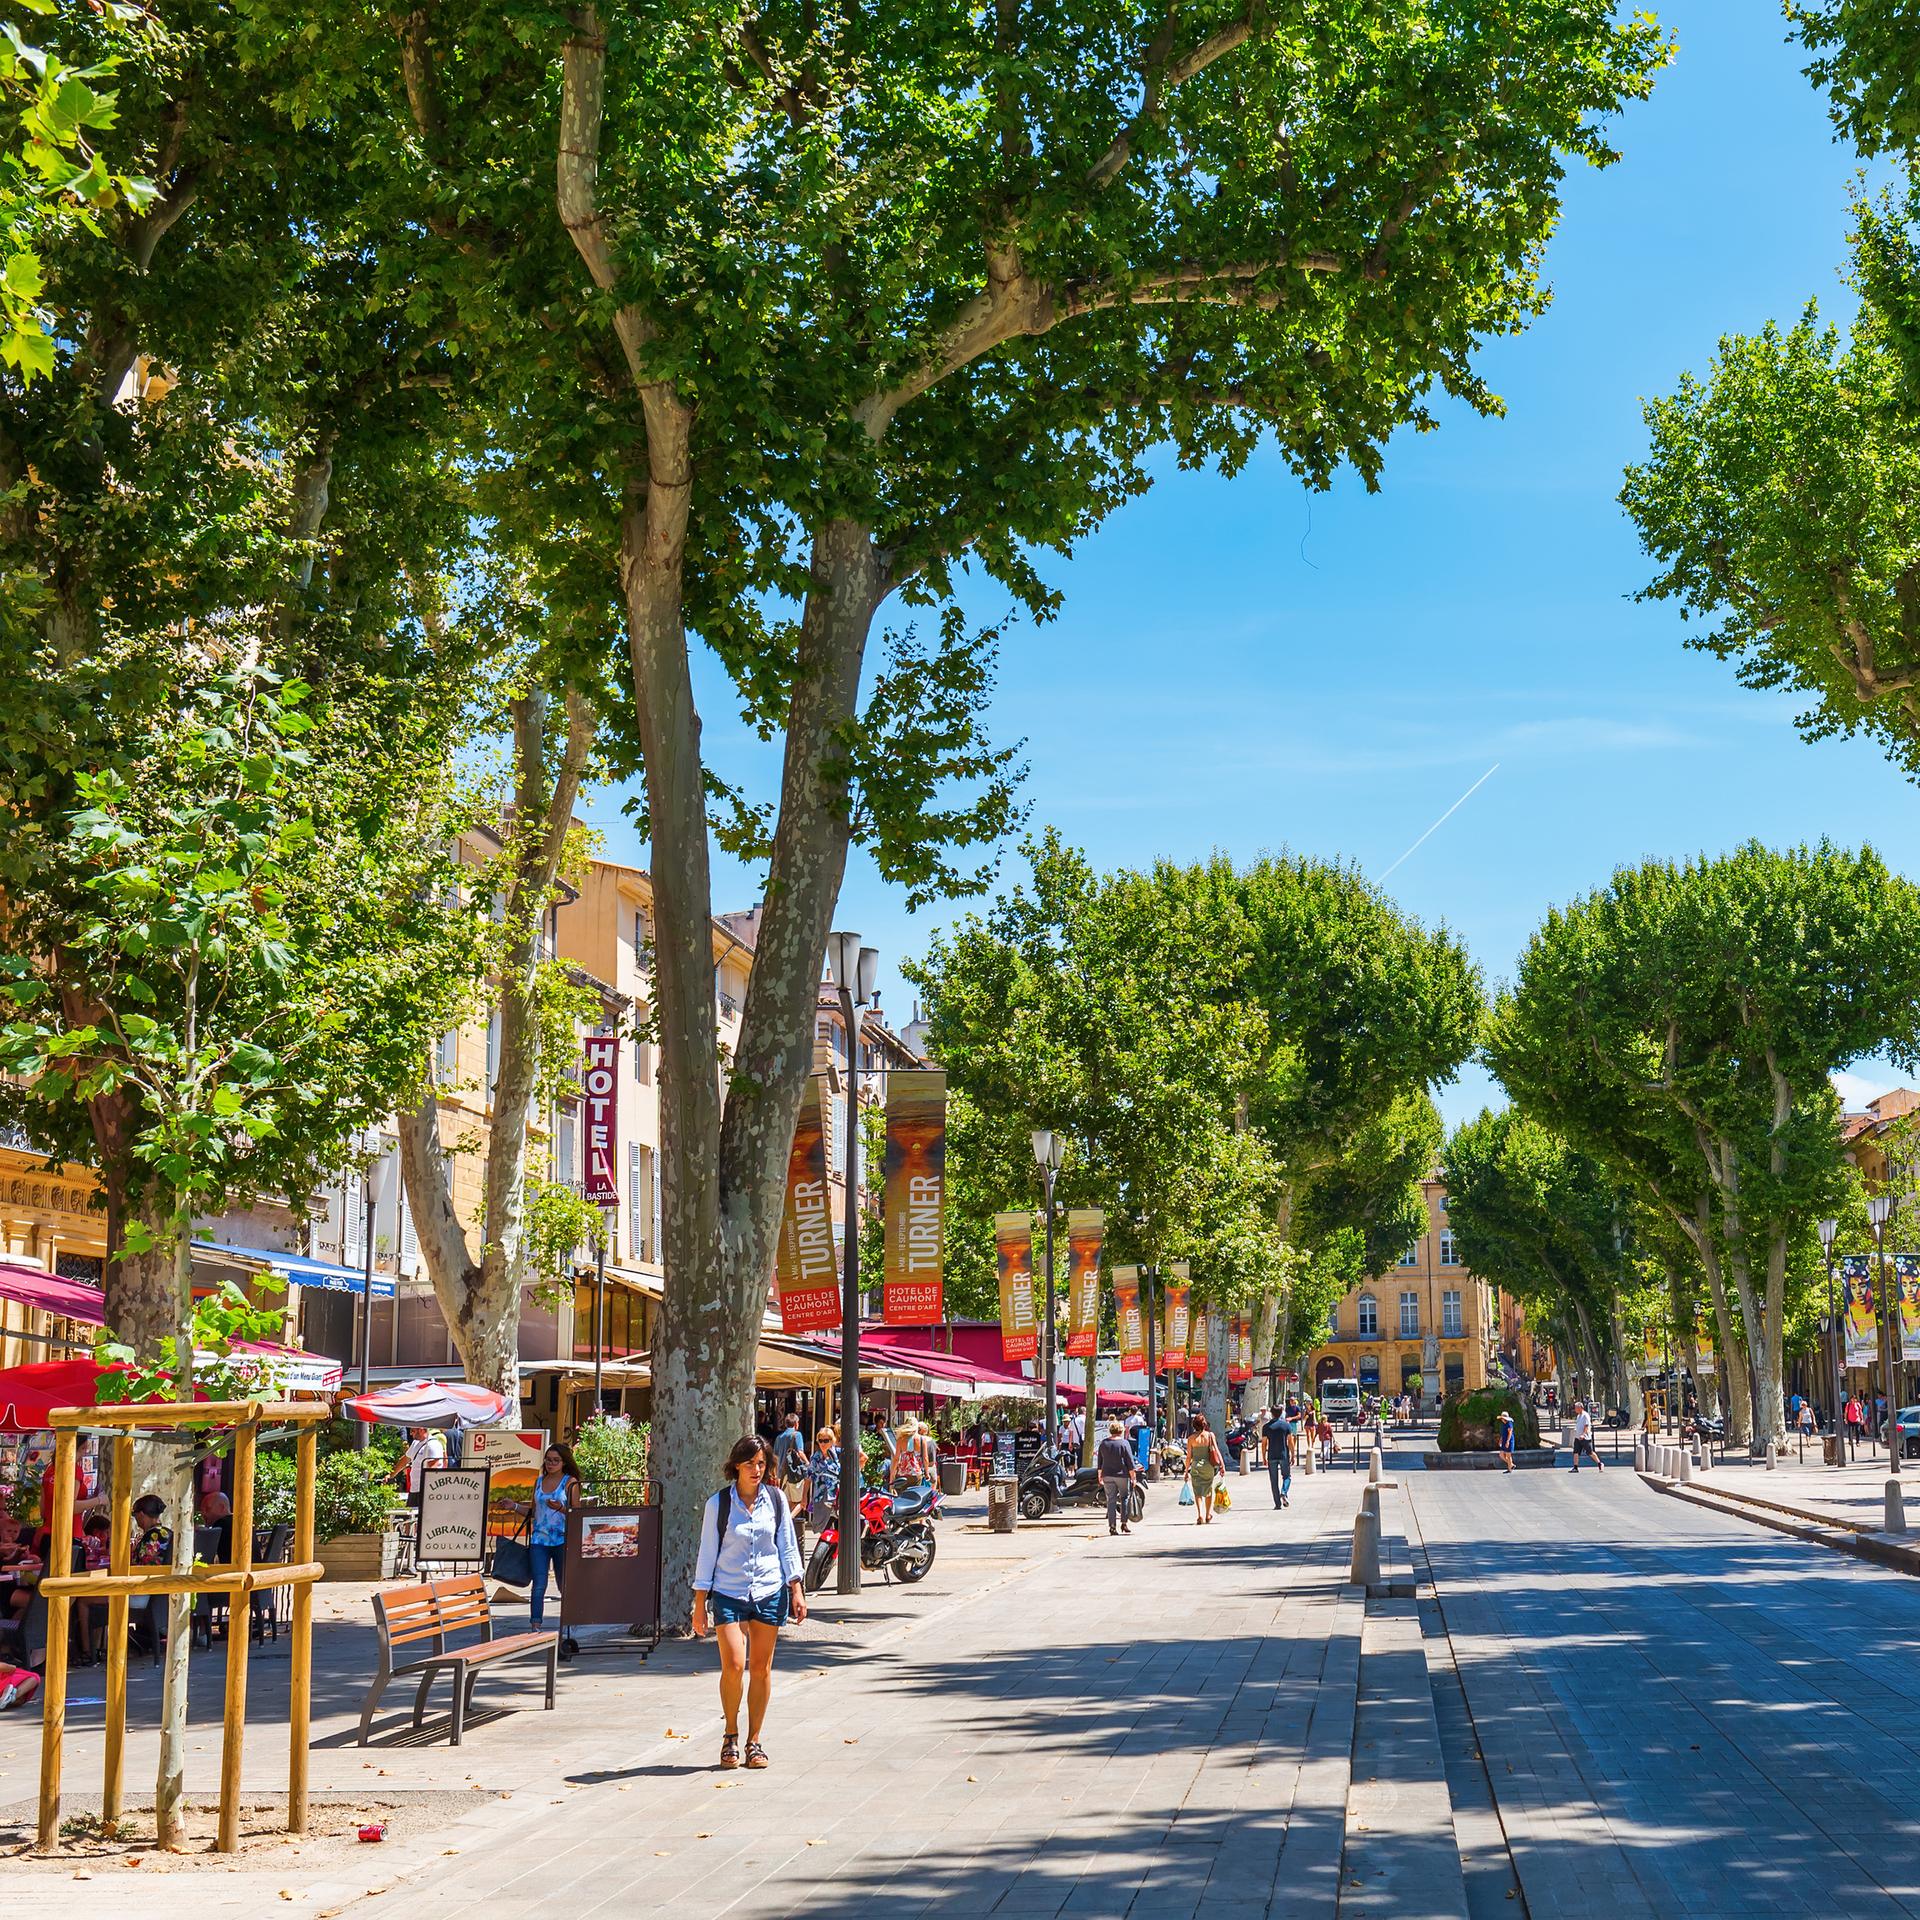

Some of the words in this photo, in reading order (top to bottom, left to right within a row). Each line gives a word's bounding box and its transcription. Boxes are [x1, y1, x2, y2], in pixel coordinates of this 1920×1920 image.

[588, 1044, 614, 1175] HOTEL
[597, 1183, 607, 1191] LA
[586, 1191, 617, 1200] BASTIDE
[794, 1179, 831, 1280] TURNER
[908, 1175, 940, 1273] TURNER
[785, 1292, 817, 1304] HOTEL
[819, 1290, 835, 1299] DE
[889, 1287, 922, 1296] HOTEL
[925, 1286, 938, 1294] DE
[1082, 1269, 1099, 1328] TURNER
[786, 1299, 835, 1312] CAUMONT
[889, 1295, 937, 1303] CAUMONT
[1012, 1271, 1034, 1330] TURNER
[787, 1311, 815, 1320] CENTRE
[816, 1308, 836, 1317] D'ART
[1126, 1308, 1142, 1350] TURNER
[1174, 1306, 1188, 1347] TURNER
[1194, 1315, 1206, 1352] TURNER
[1006, 1341, 1034, 1349] CAUMONT
[1229, 1333, 1239, 1363] TURNER
[429, 1476, 480, 1491] LIBRAIRIE
[428, 1493, 480, 1501] GOULARD
[426, 1525, 477, 1541] LIBRAIRIE
